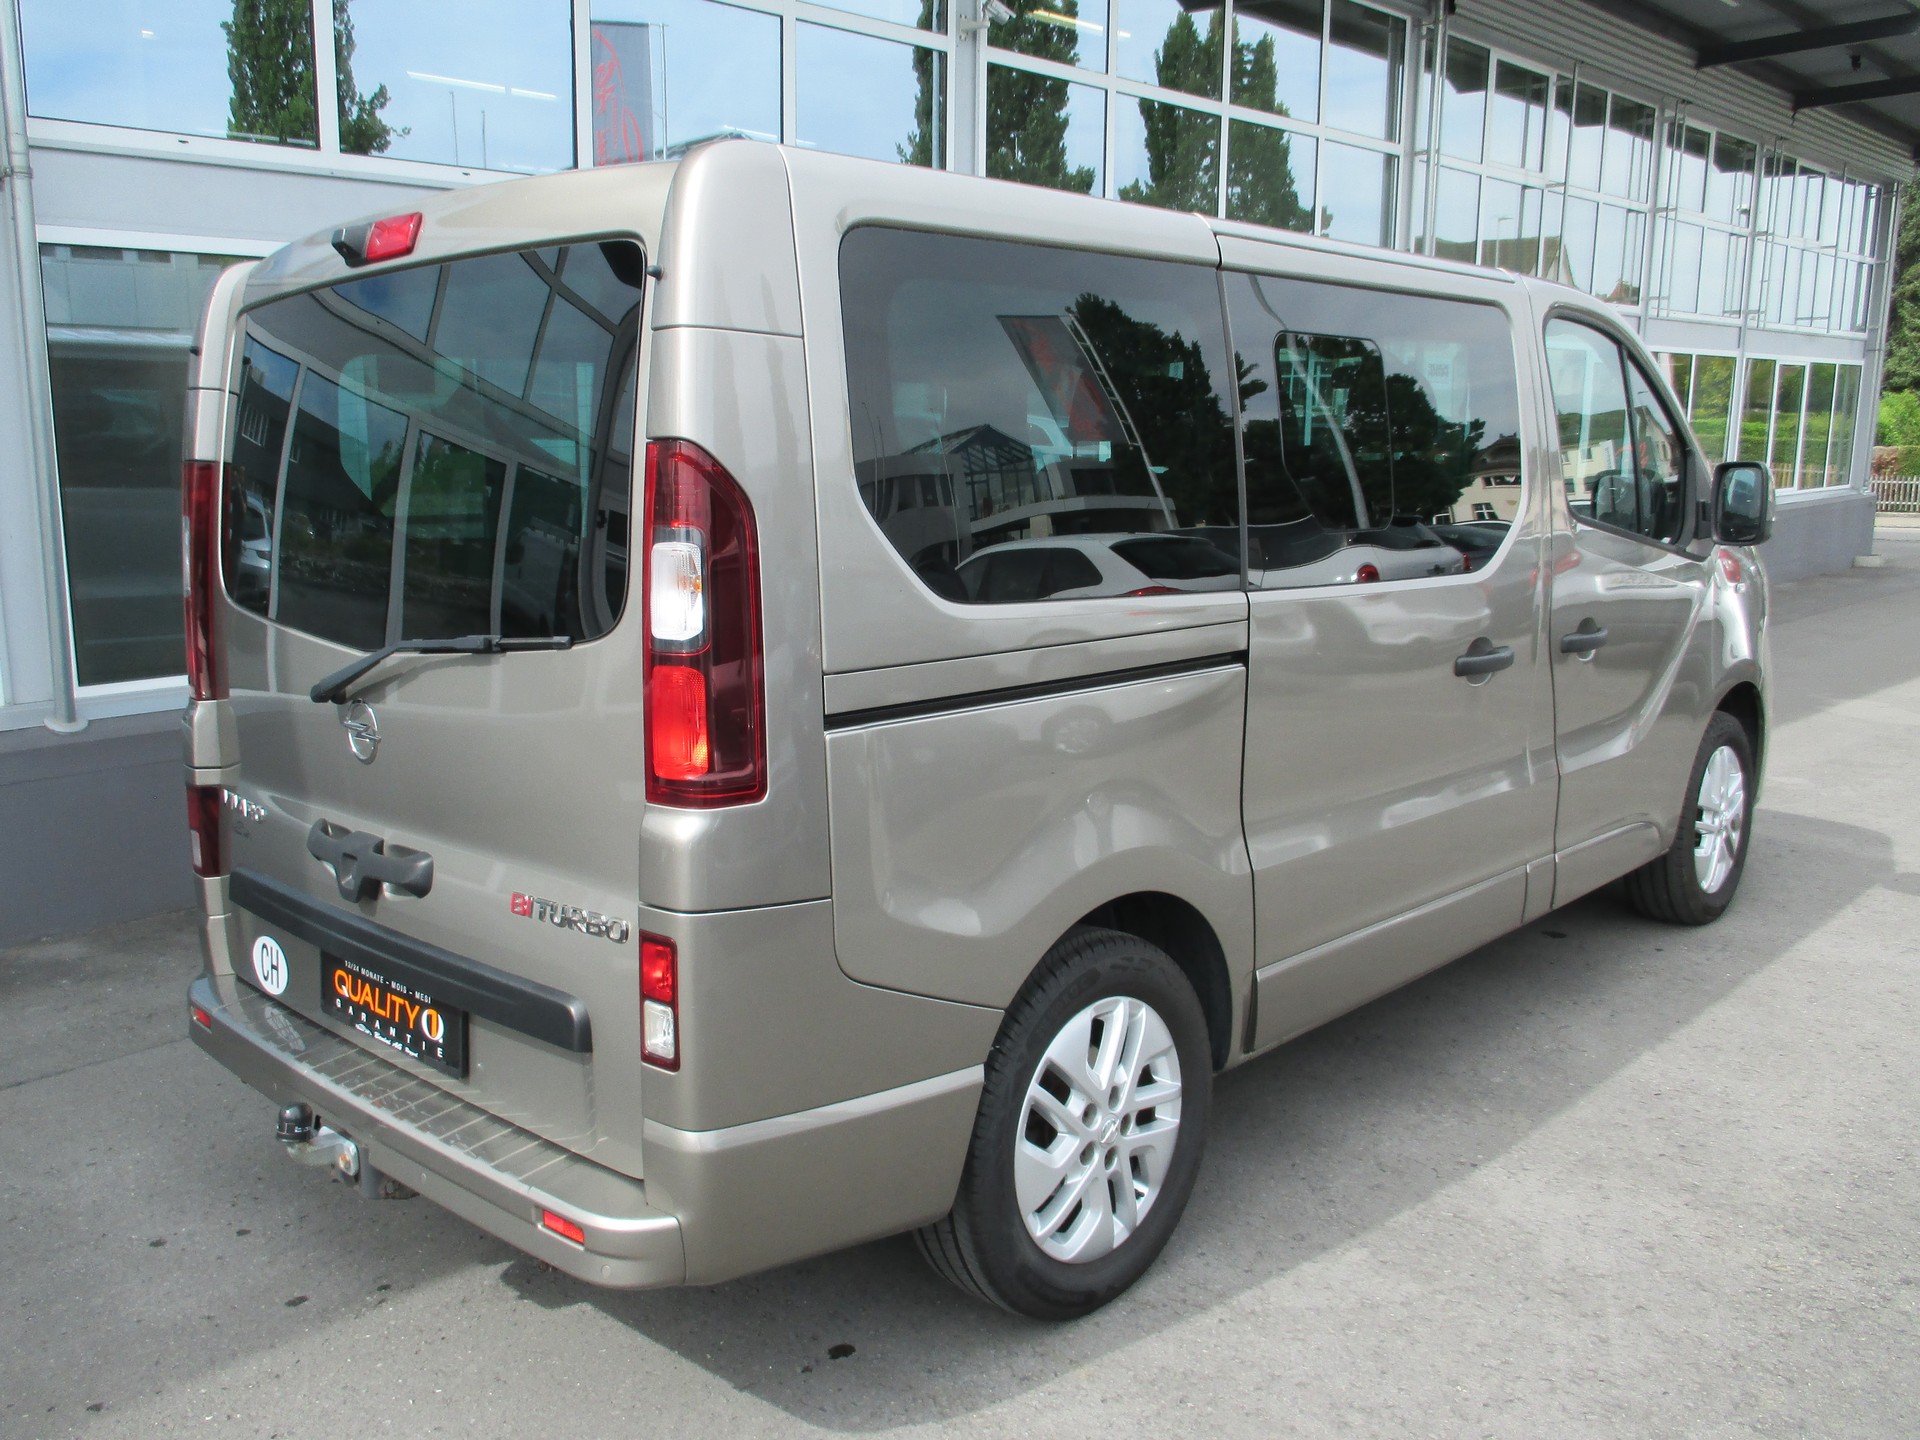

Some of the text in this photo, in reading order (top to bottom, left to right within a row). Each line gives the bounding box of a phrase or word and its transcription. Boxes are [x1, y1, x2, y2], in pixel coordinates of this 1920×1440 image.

[510, 892, 630, 944] BITURBO
[261, 943, 280, 989] CH
[361, 967, 384, 984] MONATE
[391, 981, 407, 994] MOIS
[334, 969, 421, 1029] QUALITY
[335, 998, 444, 1059] GARANTIE
